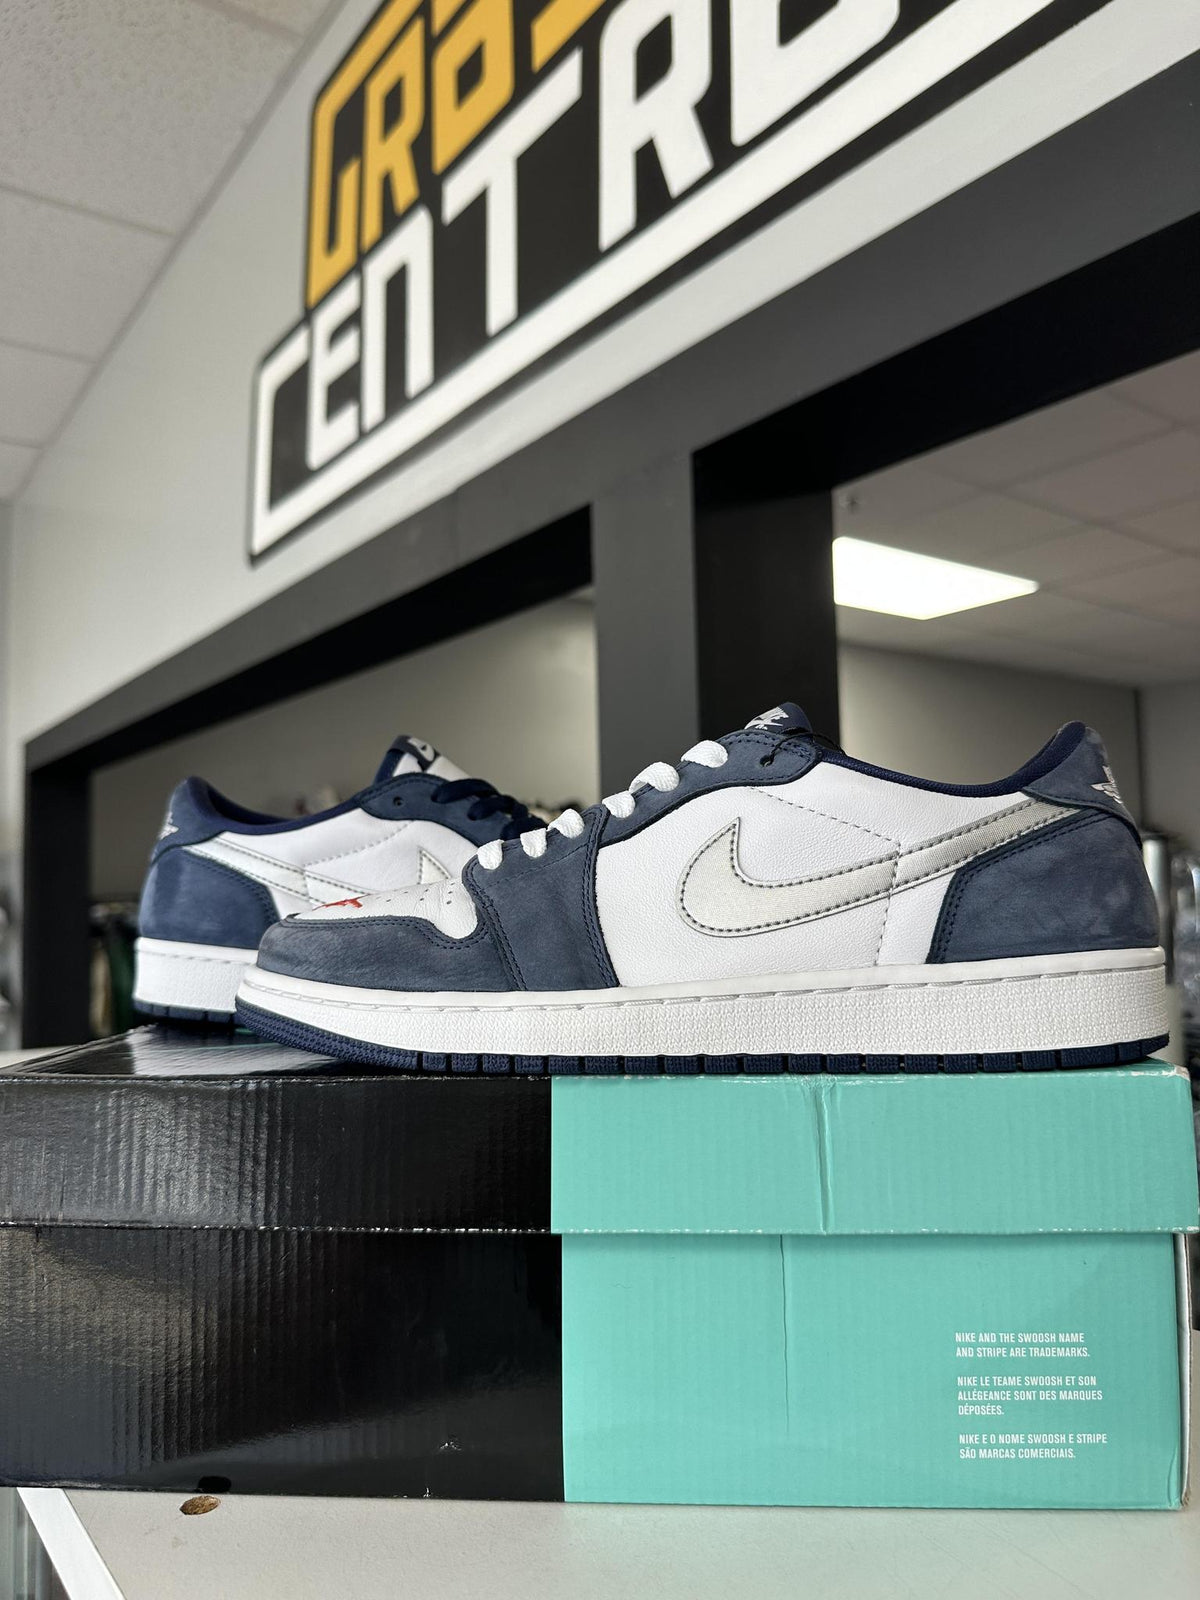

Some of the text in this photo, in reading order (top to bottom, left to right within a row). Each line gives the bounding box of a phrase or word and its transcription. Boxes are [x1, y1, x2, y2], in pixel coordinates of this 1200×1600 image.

[954, 1332, 1084, 1343] NIKE AND THE SWOOSH NAME
[956, 1347, 1090, 1357] AND STRIPE ARE TRADEMARKS.
[957, 1376, 1096, 1386] NIKE LE TEAME SWOOSH ET SON
[958, 1389, 1103, 1400] ALLÉGEANCE SONT DES MARQUES
[958, 1403, 1004, 1415] DÉPOSÉES.
[959, 1433, 1107, 1444] NIKE E O NOME SWOOSH E STRIPE
[960, 1447, 1076, 1459] SÃO MARCAS COMERCIAIS.
